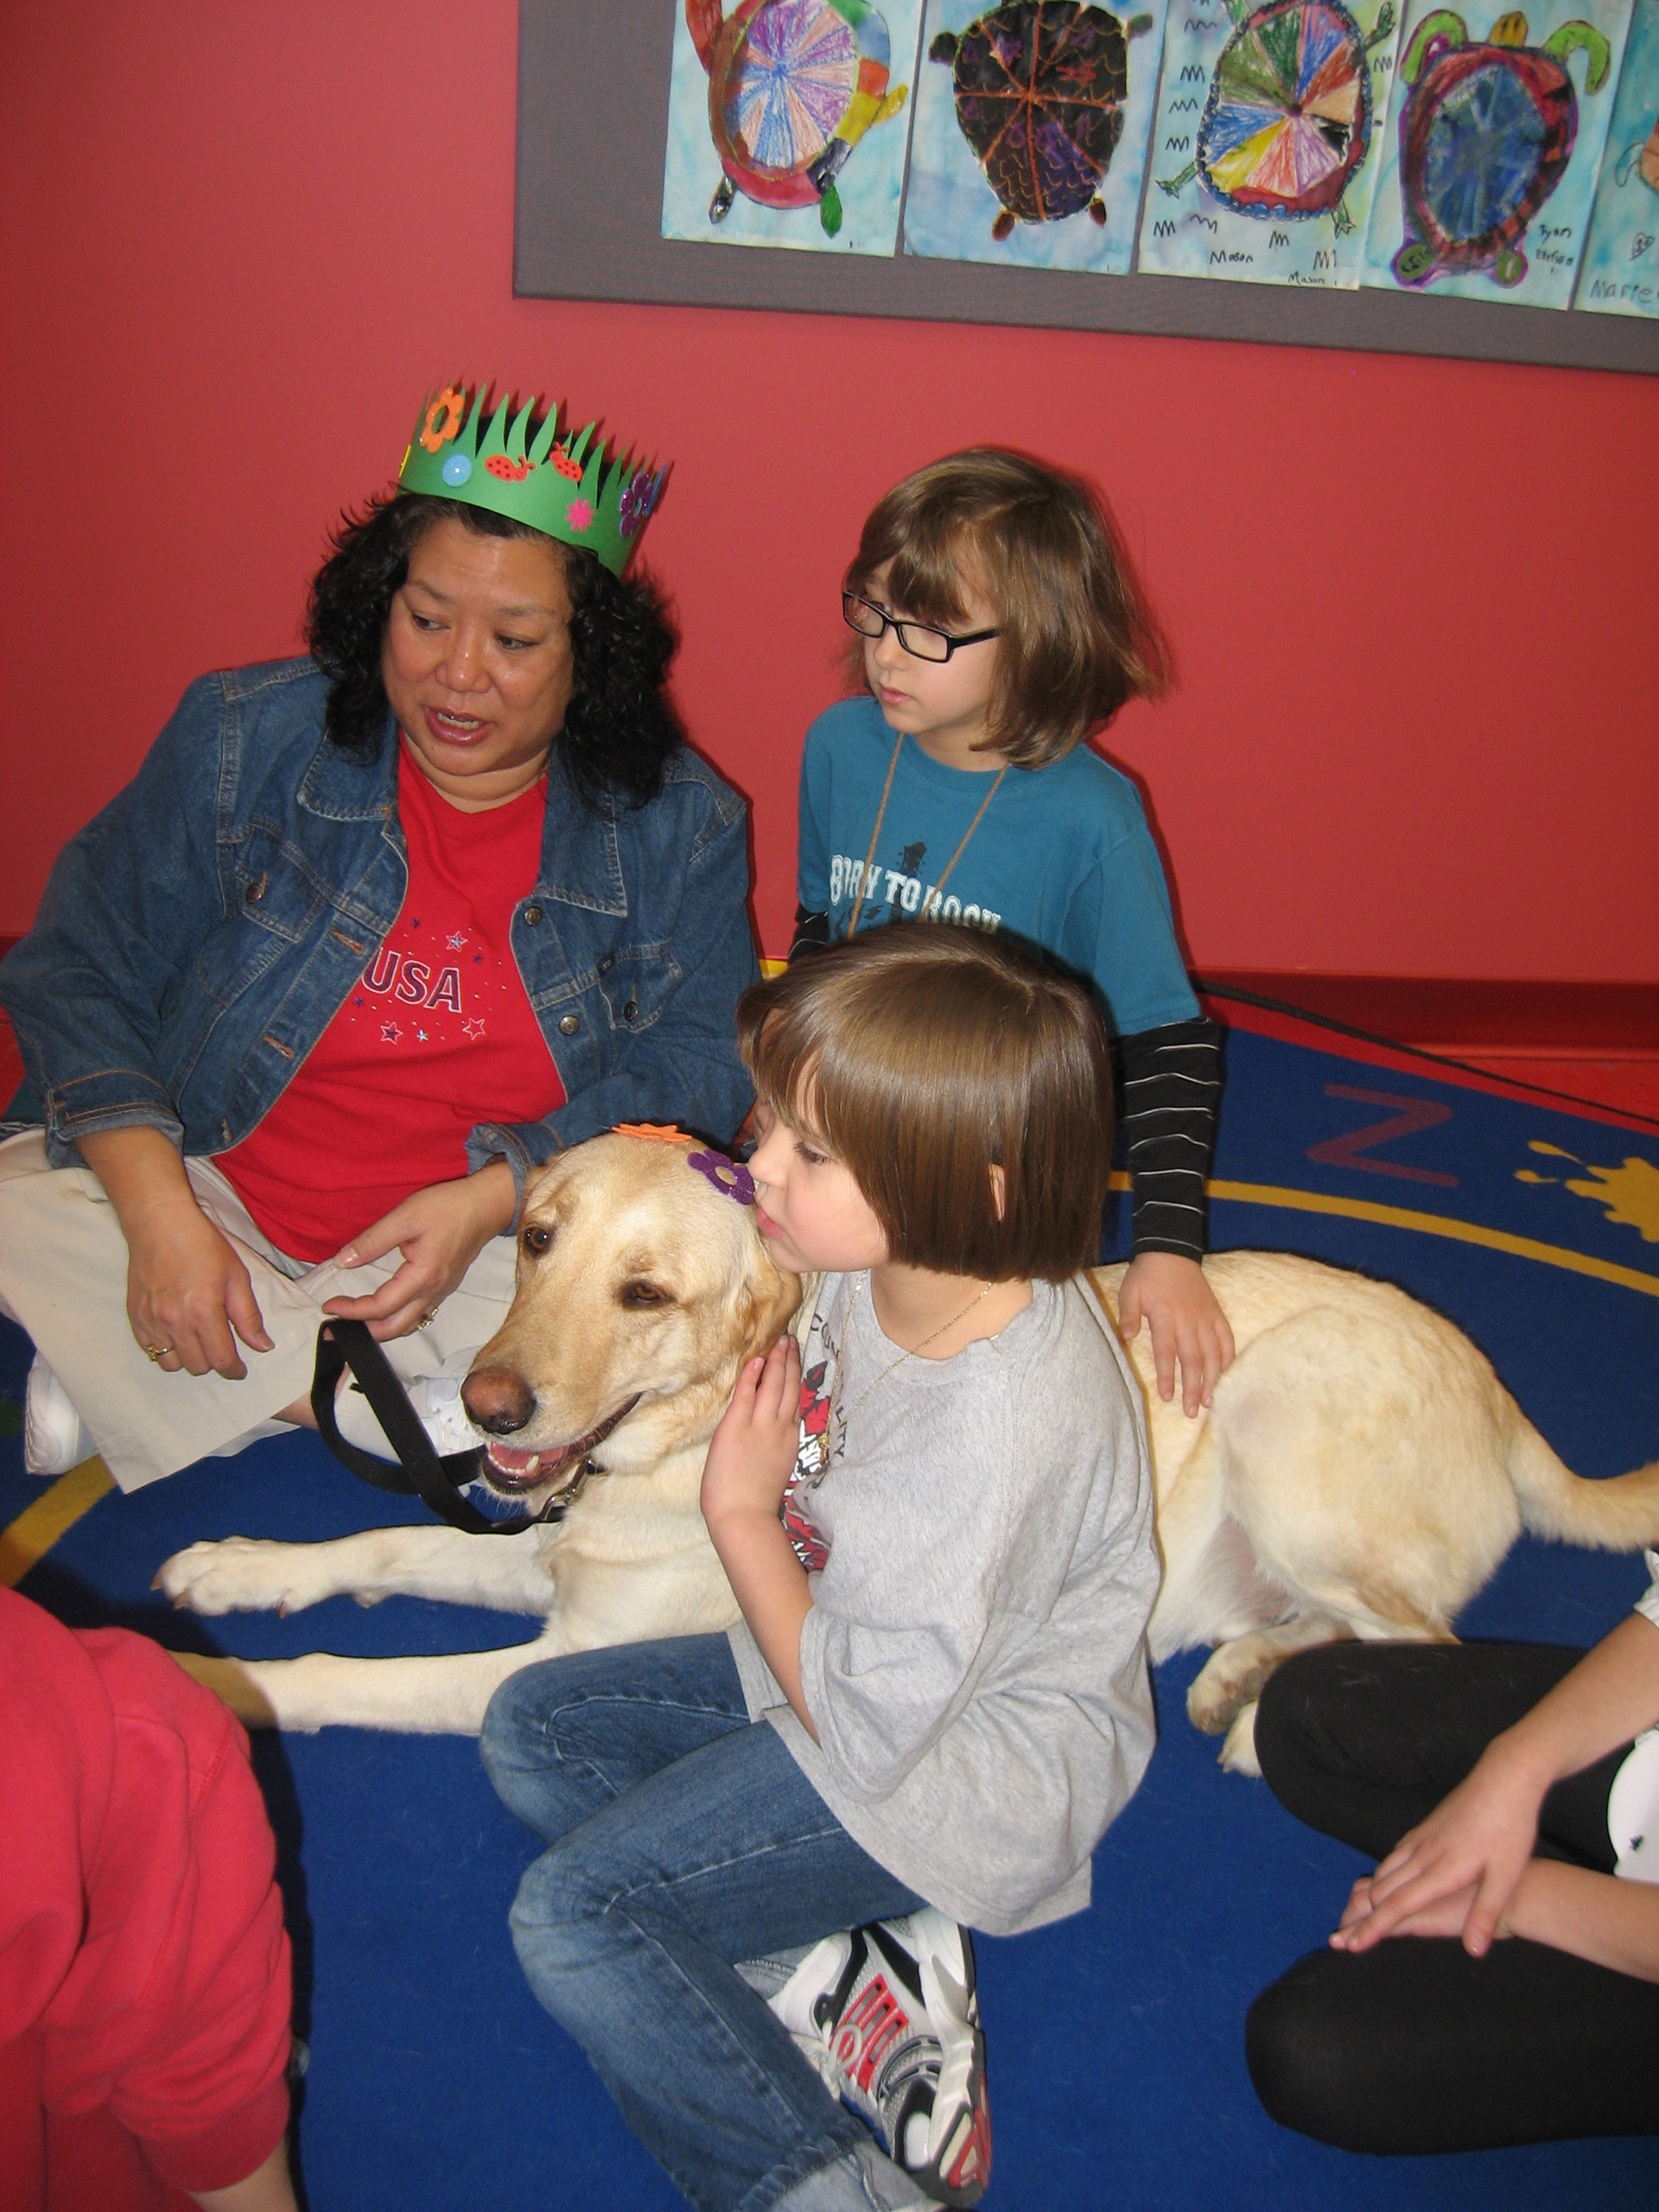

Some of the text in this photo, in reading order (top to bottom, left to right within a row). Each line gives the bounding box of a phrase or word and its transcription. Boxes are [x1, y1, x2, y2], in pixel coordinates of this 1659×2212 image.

[1210, 250, 1254, 264] Mason
[1287, 270, 1325, 285] Mason
[885, 869, 921, 912] TO
[362, 947, 462, 1014] USA
